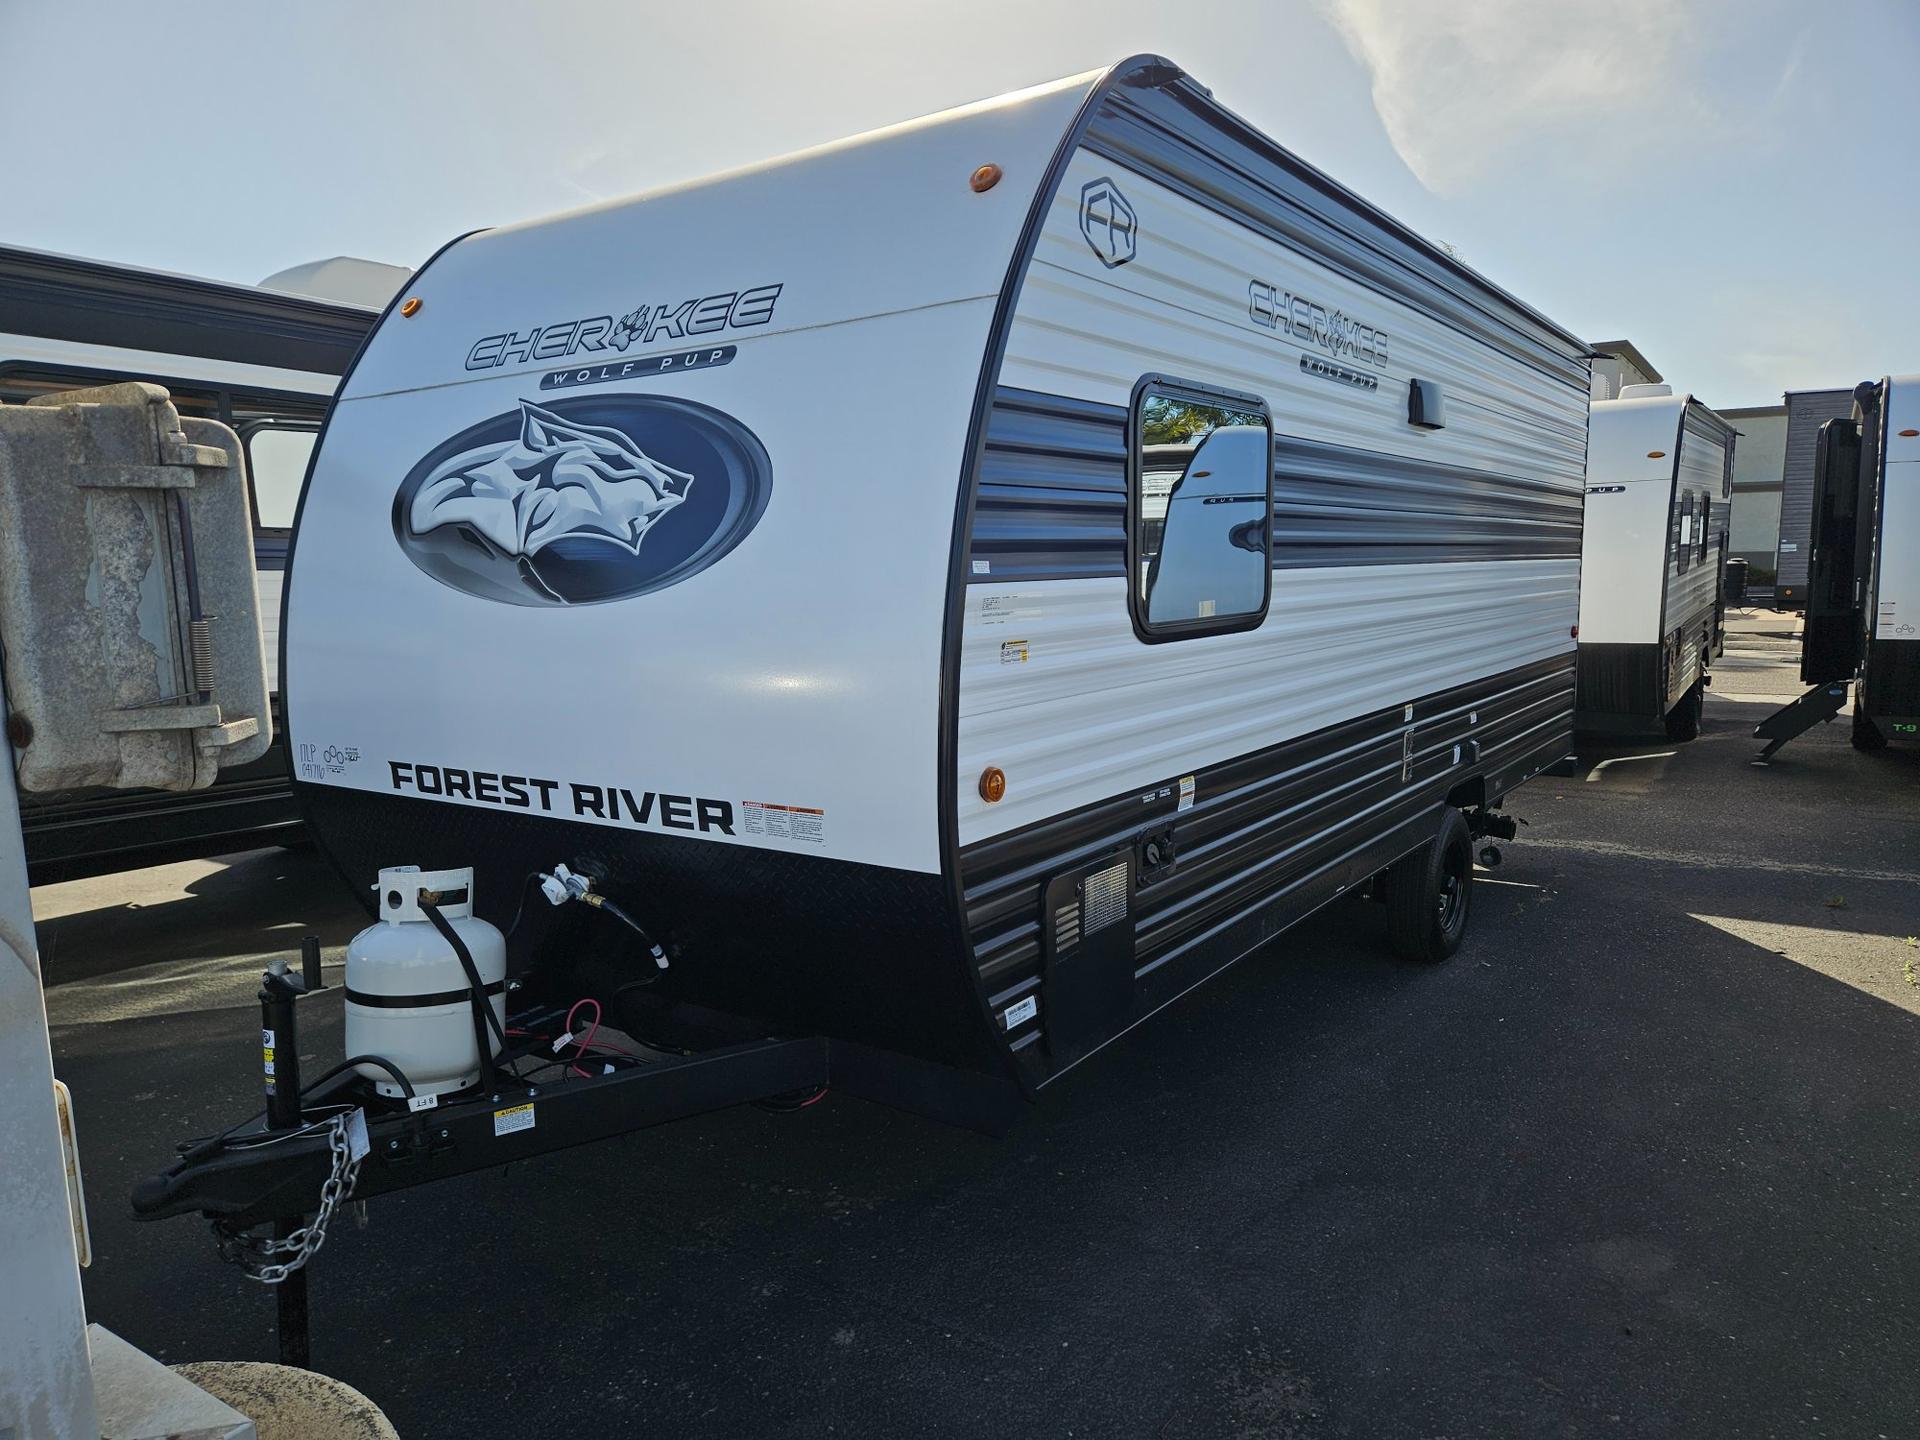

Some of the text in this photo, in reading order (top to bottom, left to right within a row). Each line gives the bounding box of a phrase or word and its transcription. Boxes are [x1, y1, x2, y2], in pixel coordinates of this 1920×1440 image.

[465, 283, 784, 371] CHEROKEE
[1249, 279, 1388, 368] CHEROKEE
[552, 349, 724, 385] WOLF PUP
[1306, 358, 1375, 388] WOLF PUP
[388, 760, 559, 811] FOREST
[569, 782, 737, 836] RIVER
[505, 1105, 528, 1115] CAUTION
